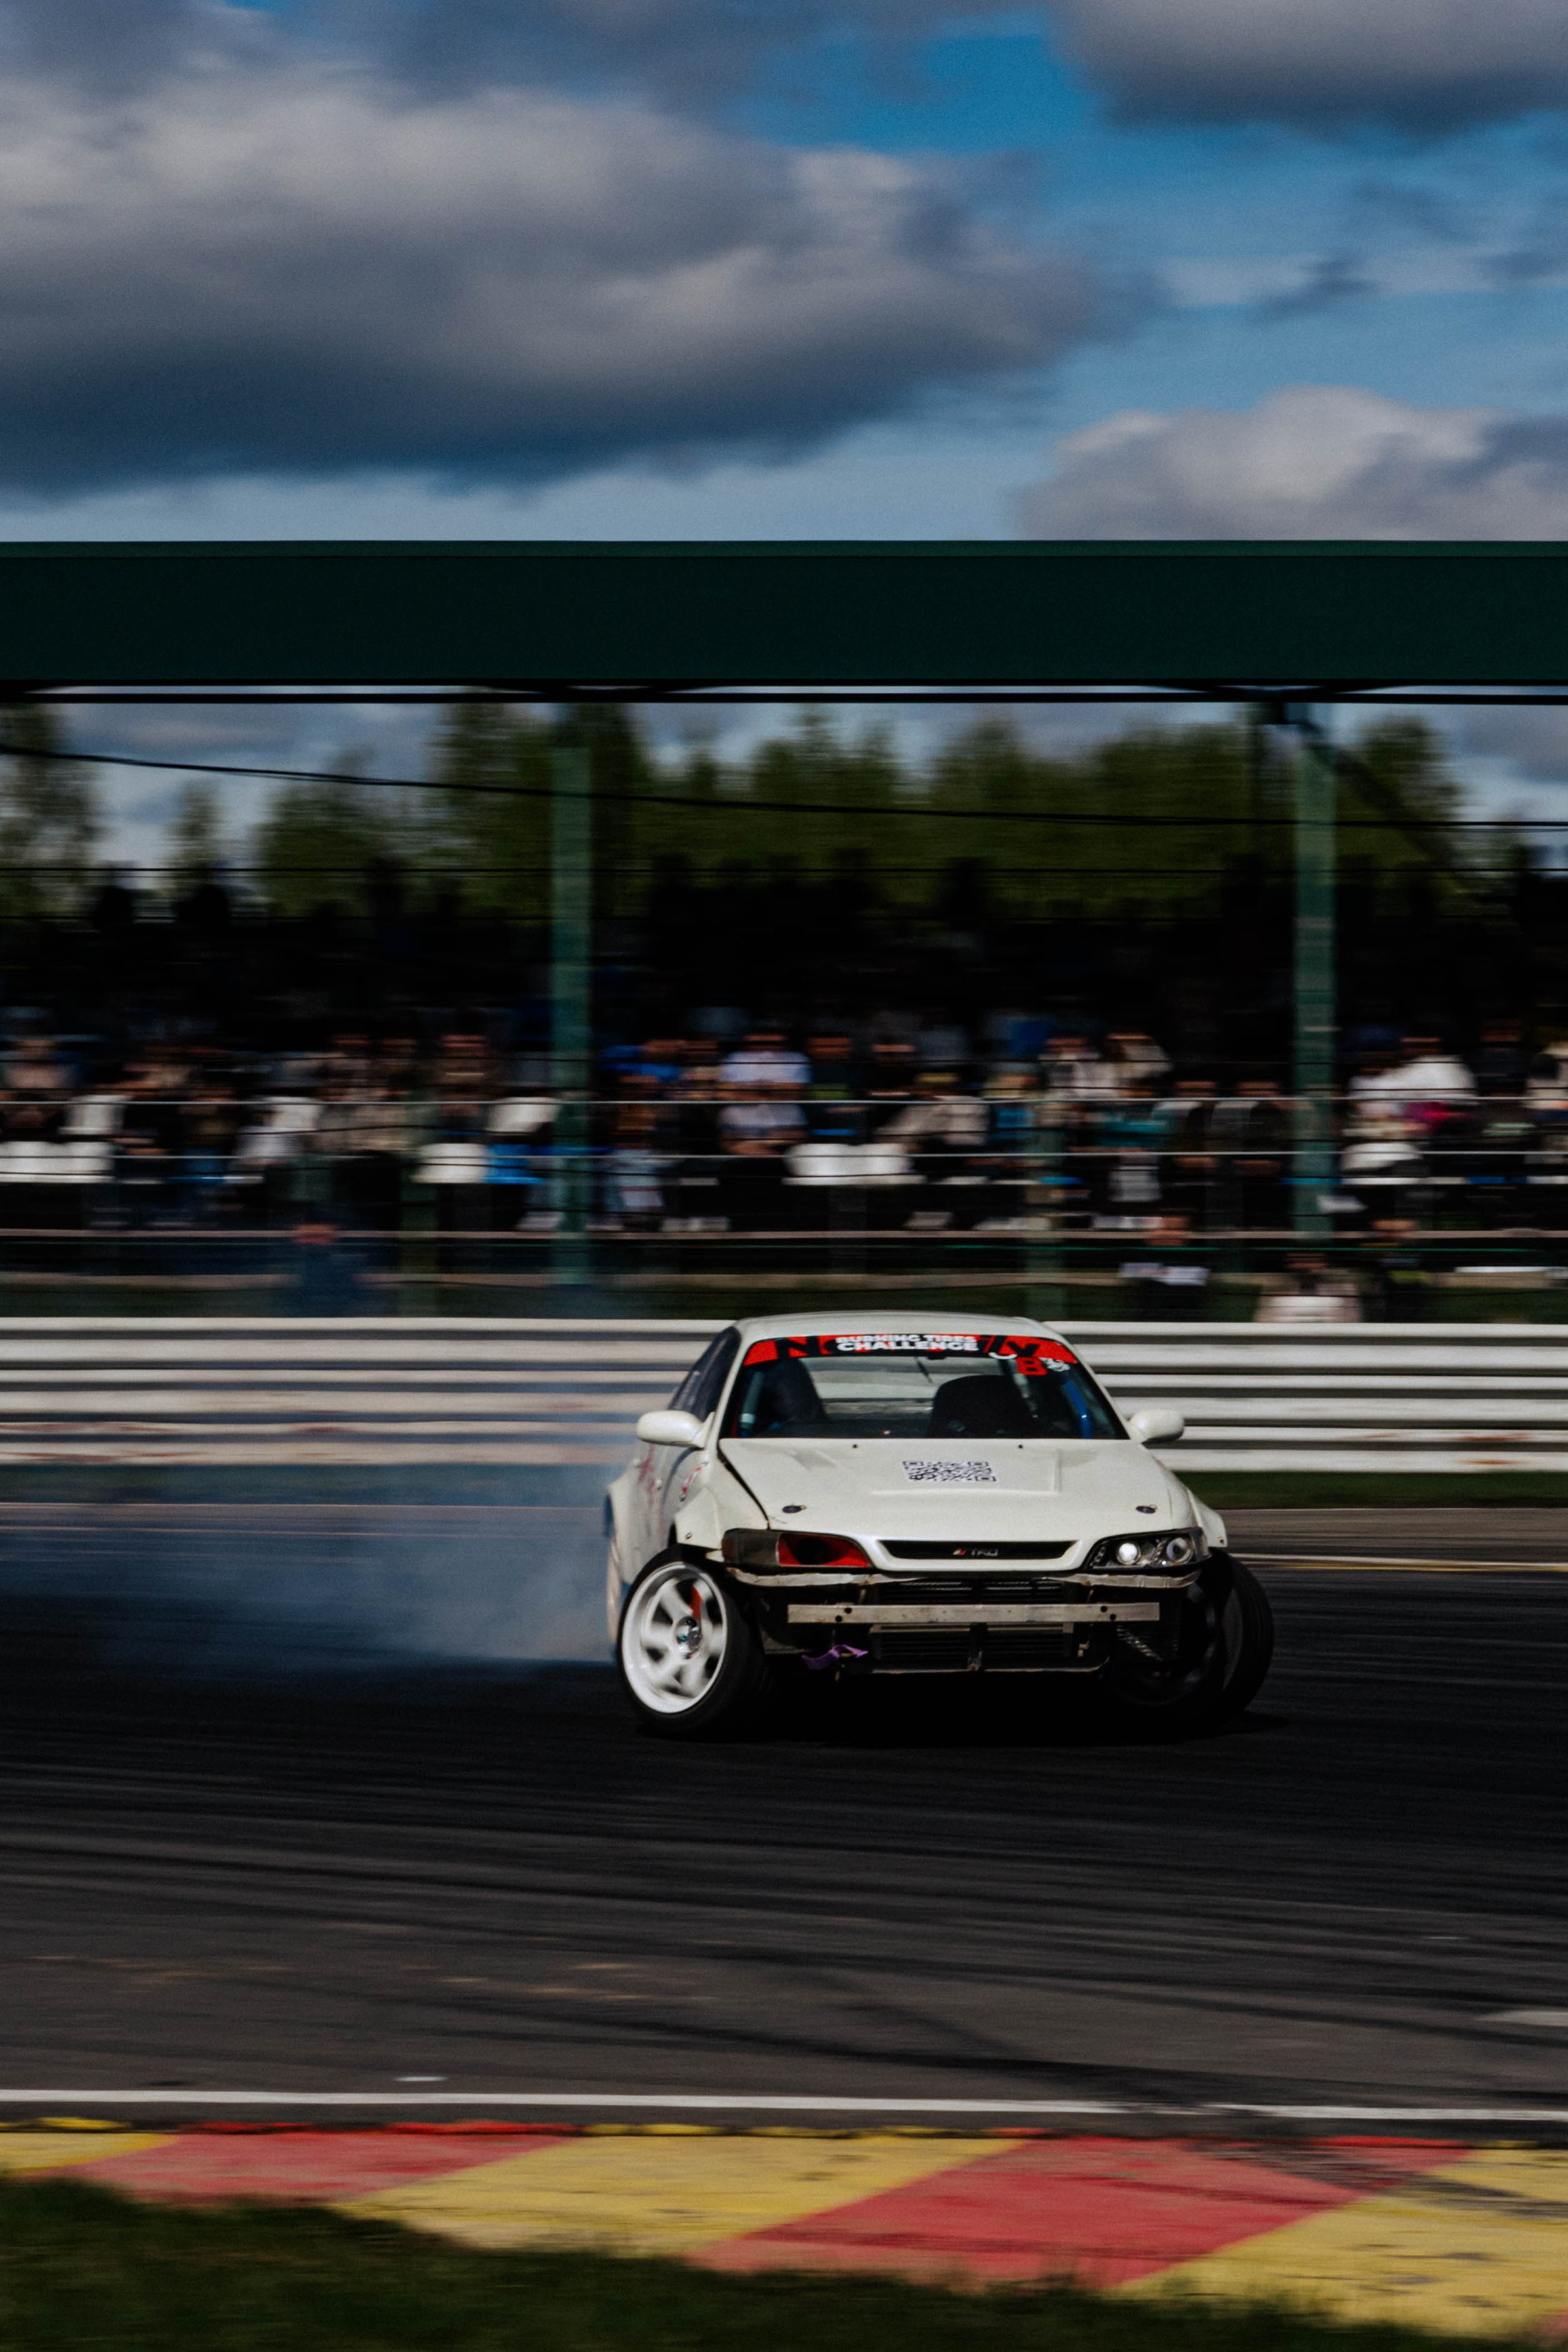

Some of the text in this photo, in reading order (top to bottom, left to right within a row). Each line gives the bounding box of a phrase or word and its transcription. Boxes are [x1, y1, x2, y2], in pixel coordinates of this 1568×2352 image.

[835, 1335, 977, 1344] BURNING TIRES
[837, 1341, 979, 1351] CHALLENGE
